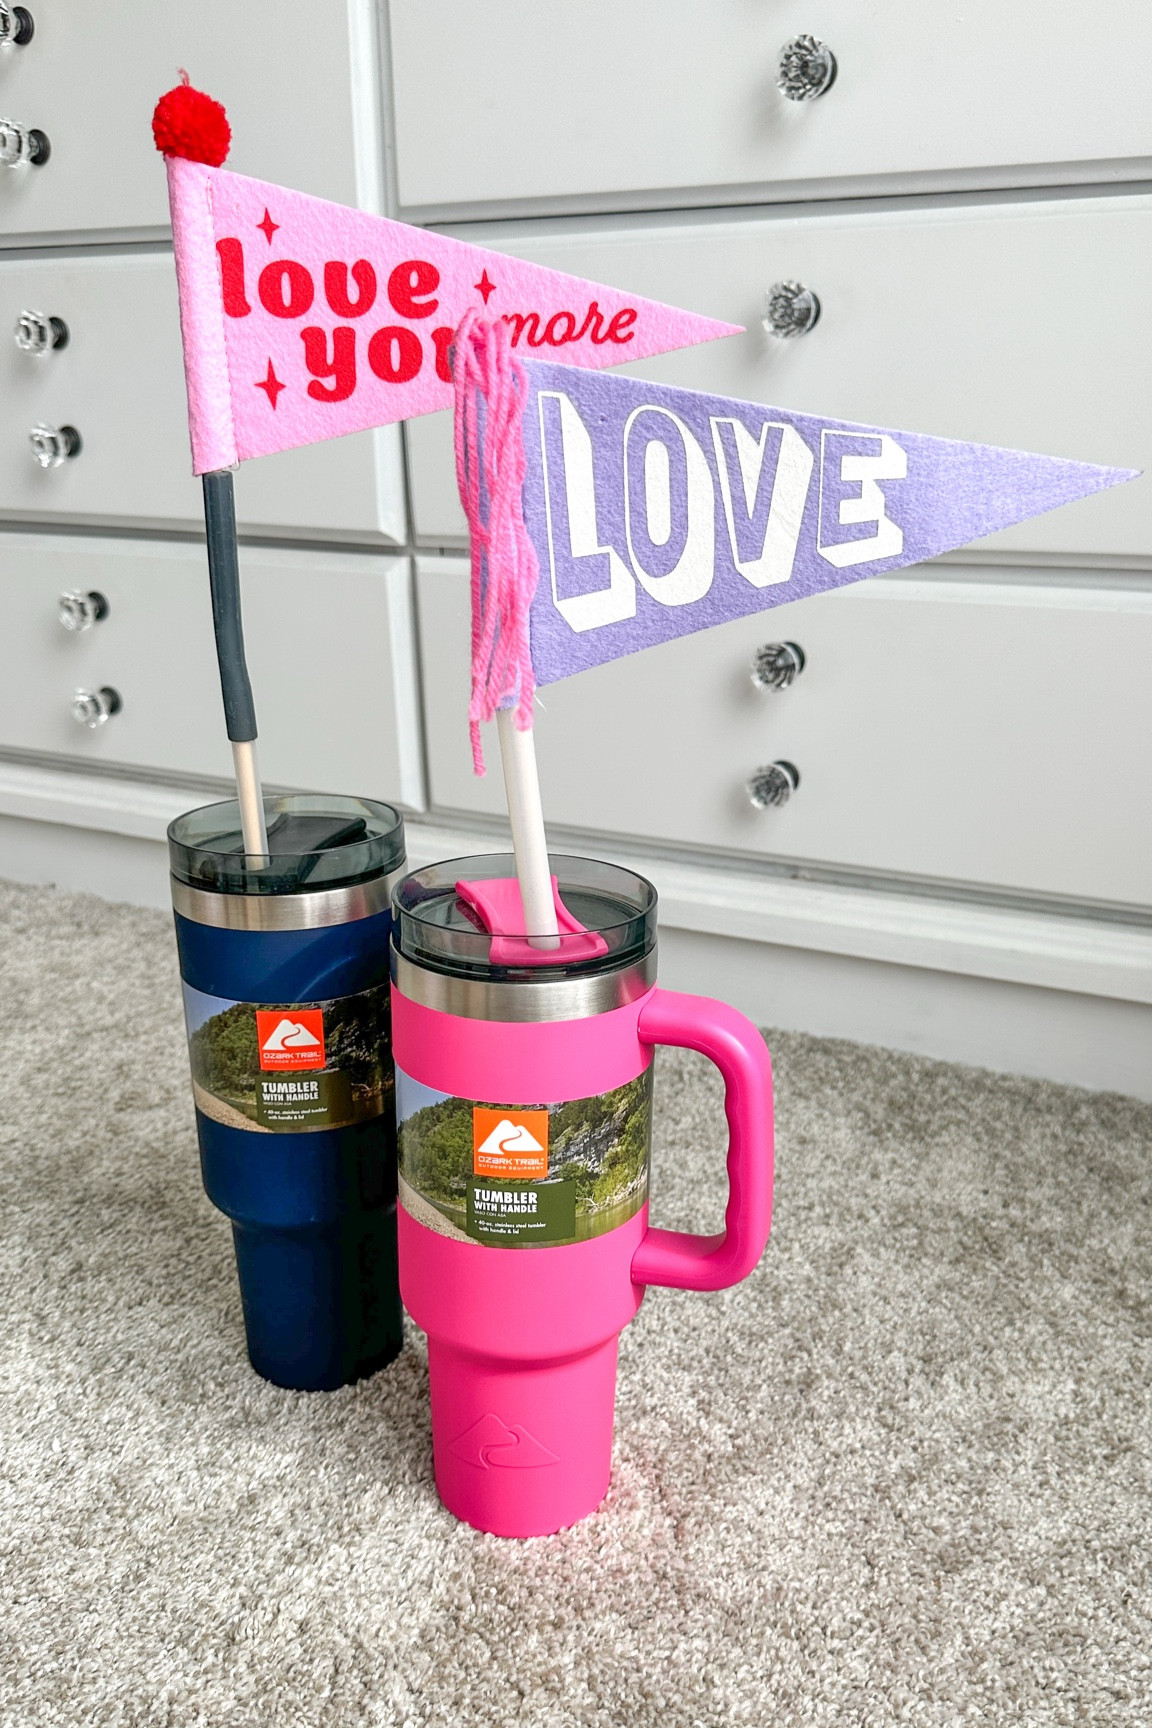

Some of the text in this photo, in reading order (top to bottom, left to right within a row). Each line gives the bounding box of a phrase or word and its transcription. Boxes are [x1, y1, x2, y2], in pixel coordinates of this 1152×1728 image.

[216, 237, 441, 319] love
[502, 301, 637, 348] more
[538, 391, 907, 633] LOVE
[261, 1081, 319, 1093] TUMBLER
[262, 1092, 319, 1101] WITH HANDLE
[474, 1188, 538, 1204] TUMBLER
[474, 1200, 538, 1213] WITH HANDLE
